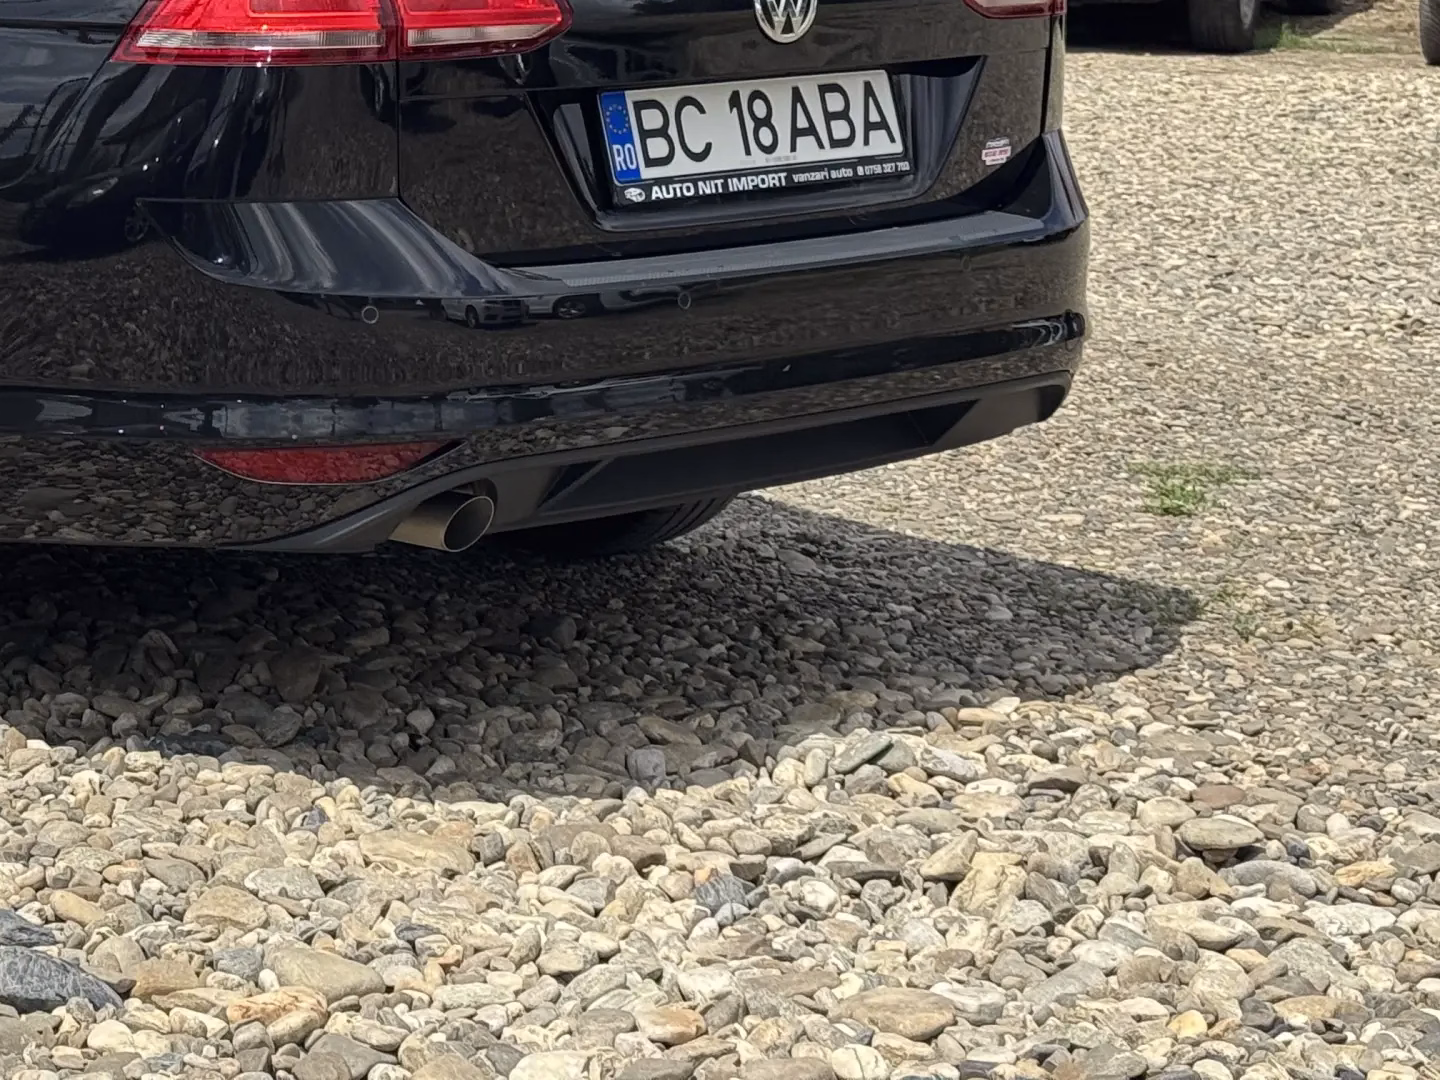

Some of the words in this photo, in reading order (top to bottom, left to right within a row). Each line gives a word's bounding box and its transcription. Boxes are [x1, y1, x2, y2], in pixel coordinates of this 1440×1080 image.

[632, 95, 712, 168] BC
[728, 89, 778, 156] 18
[790, 80, 896, 153] ABA
[613, 144, 637, 170] RO
[651, 182, 695, 200] AUTO
[698, 179, 724, 196] NIT
[728, 172, 788, 192] IMPORT
[830, 167, 853, 179] auto
